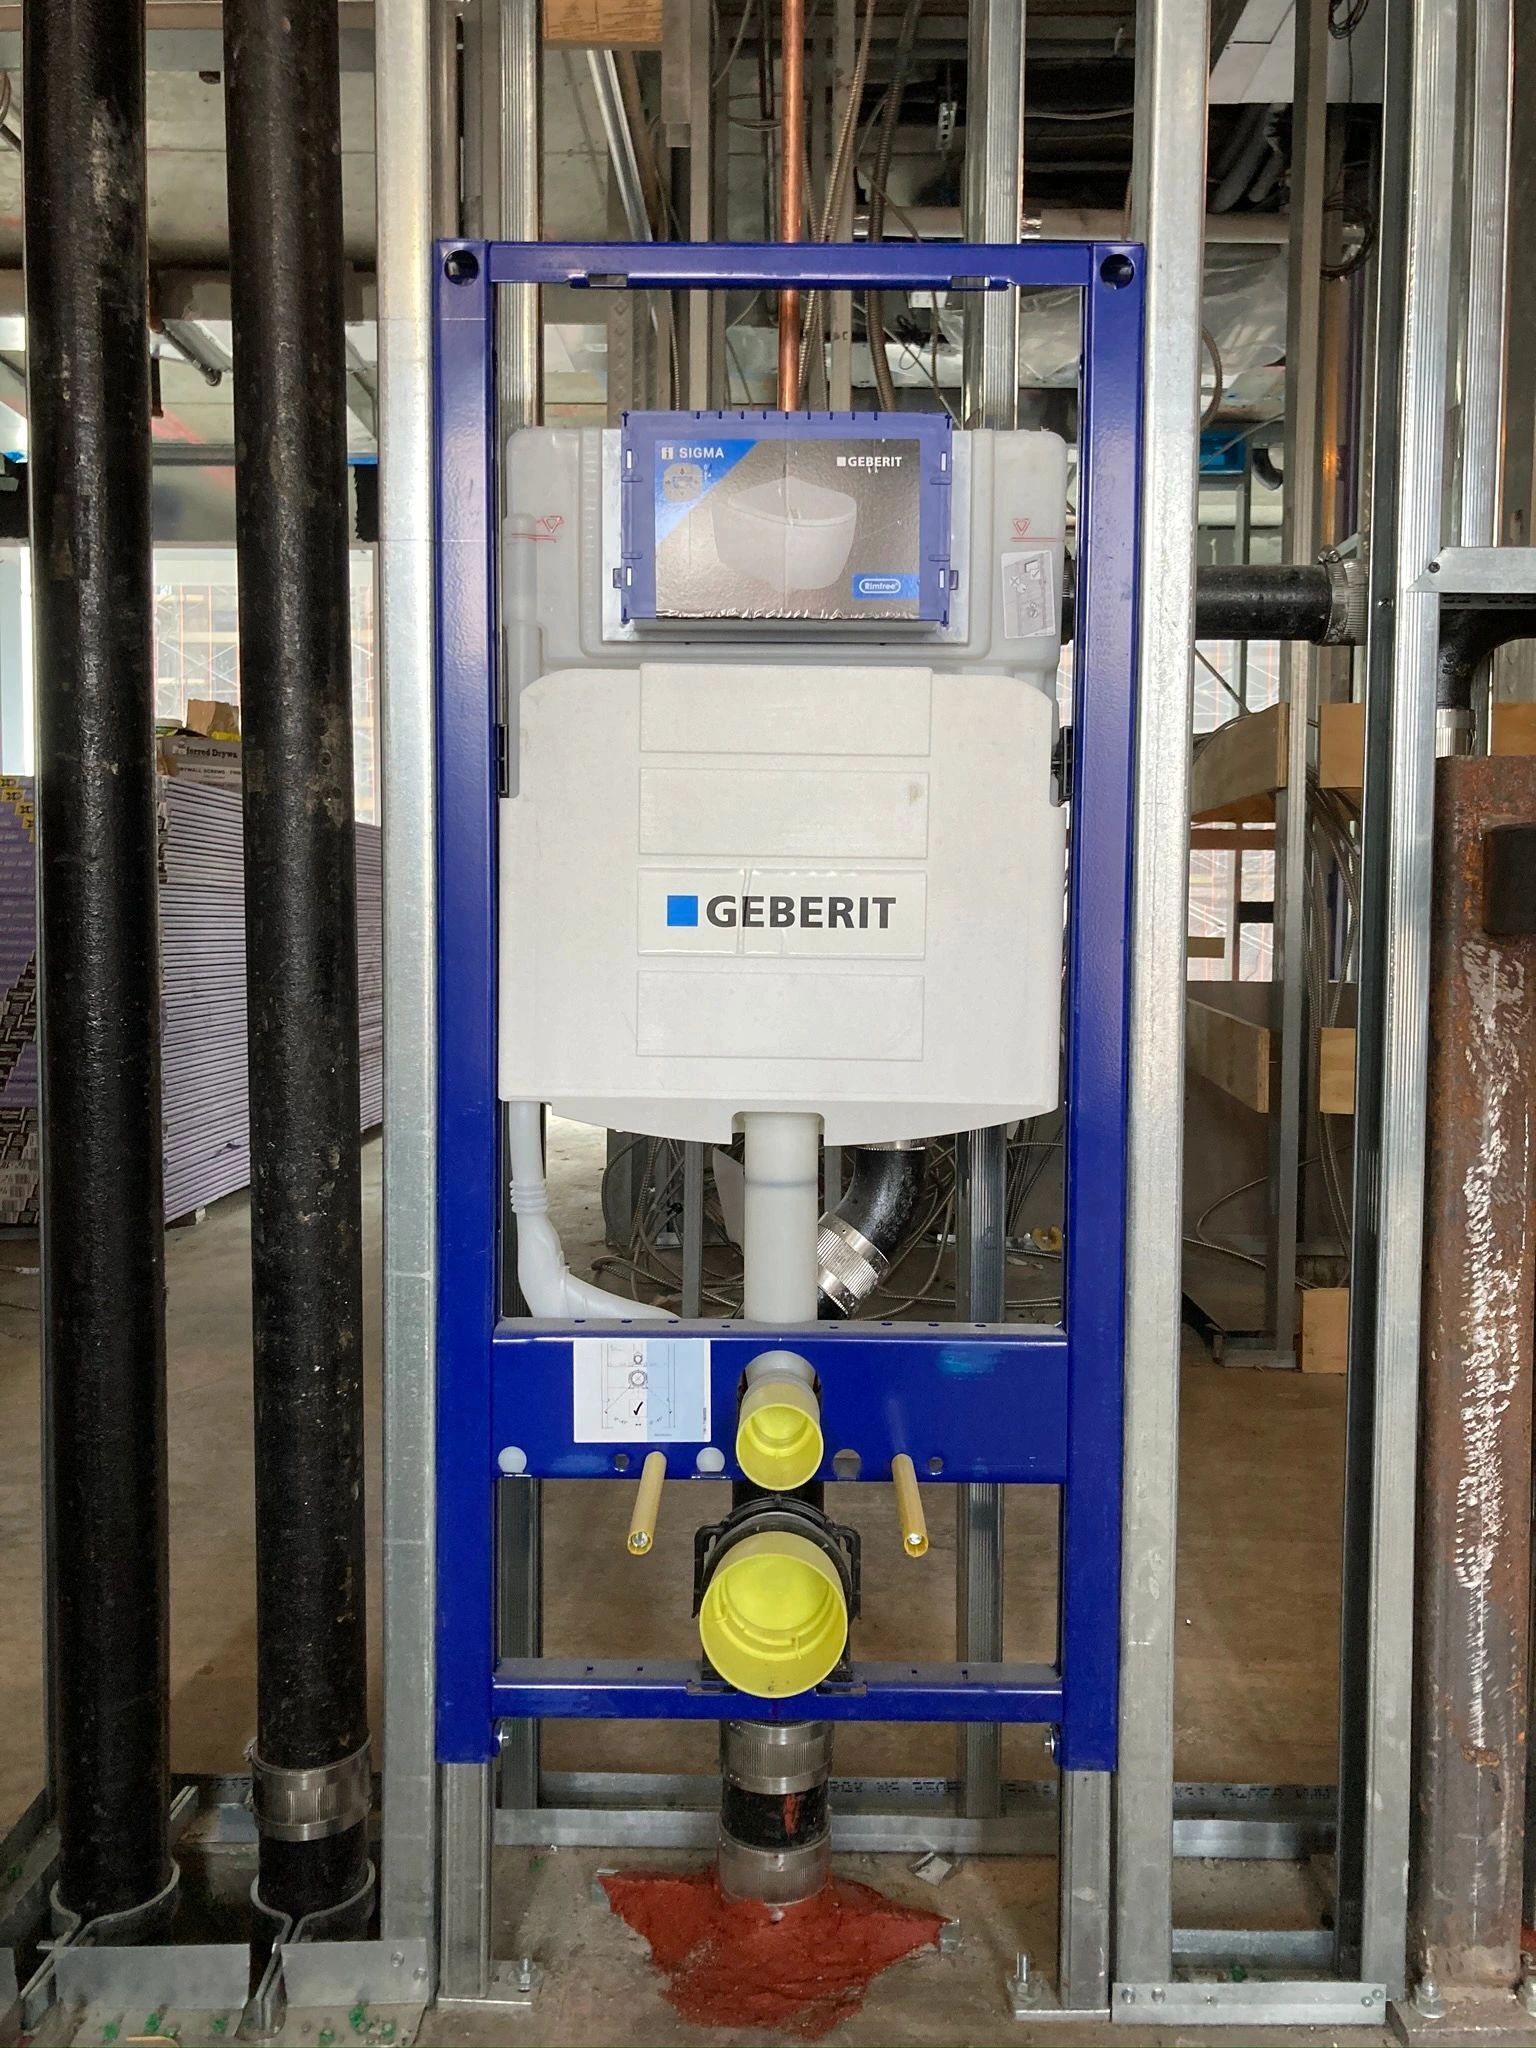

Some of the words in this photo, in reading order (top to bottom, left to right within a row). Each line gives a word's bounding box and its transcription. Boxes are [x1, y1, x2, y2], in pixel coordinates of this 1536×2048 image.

[679, 447, 725, 459] SIGMA
[848, 456, 902, 468] GEBERIT
[706, 895, 896, 929] GEBERIT
